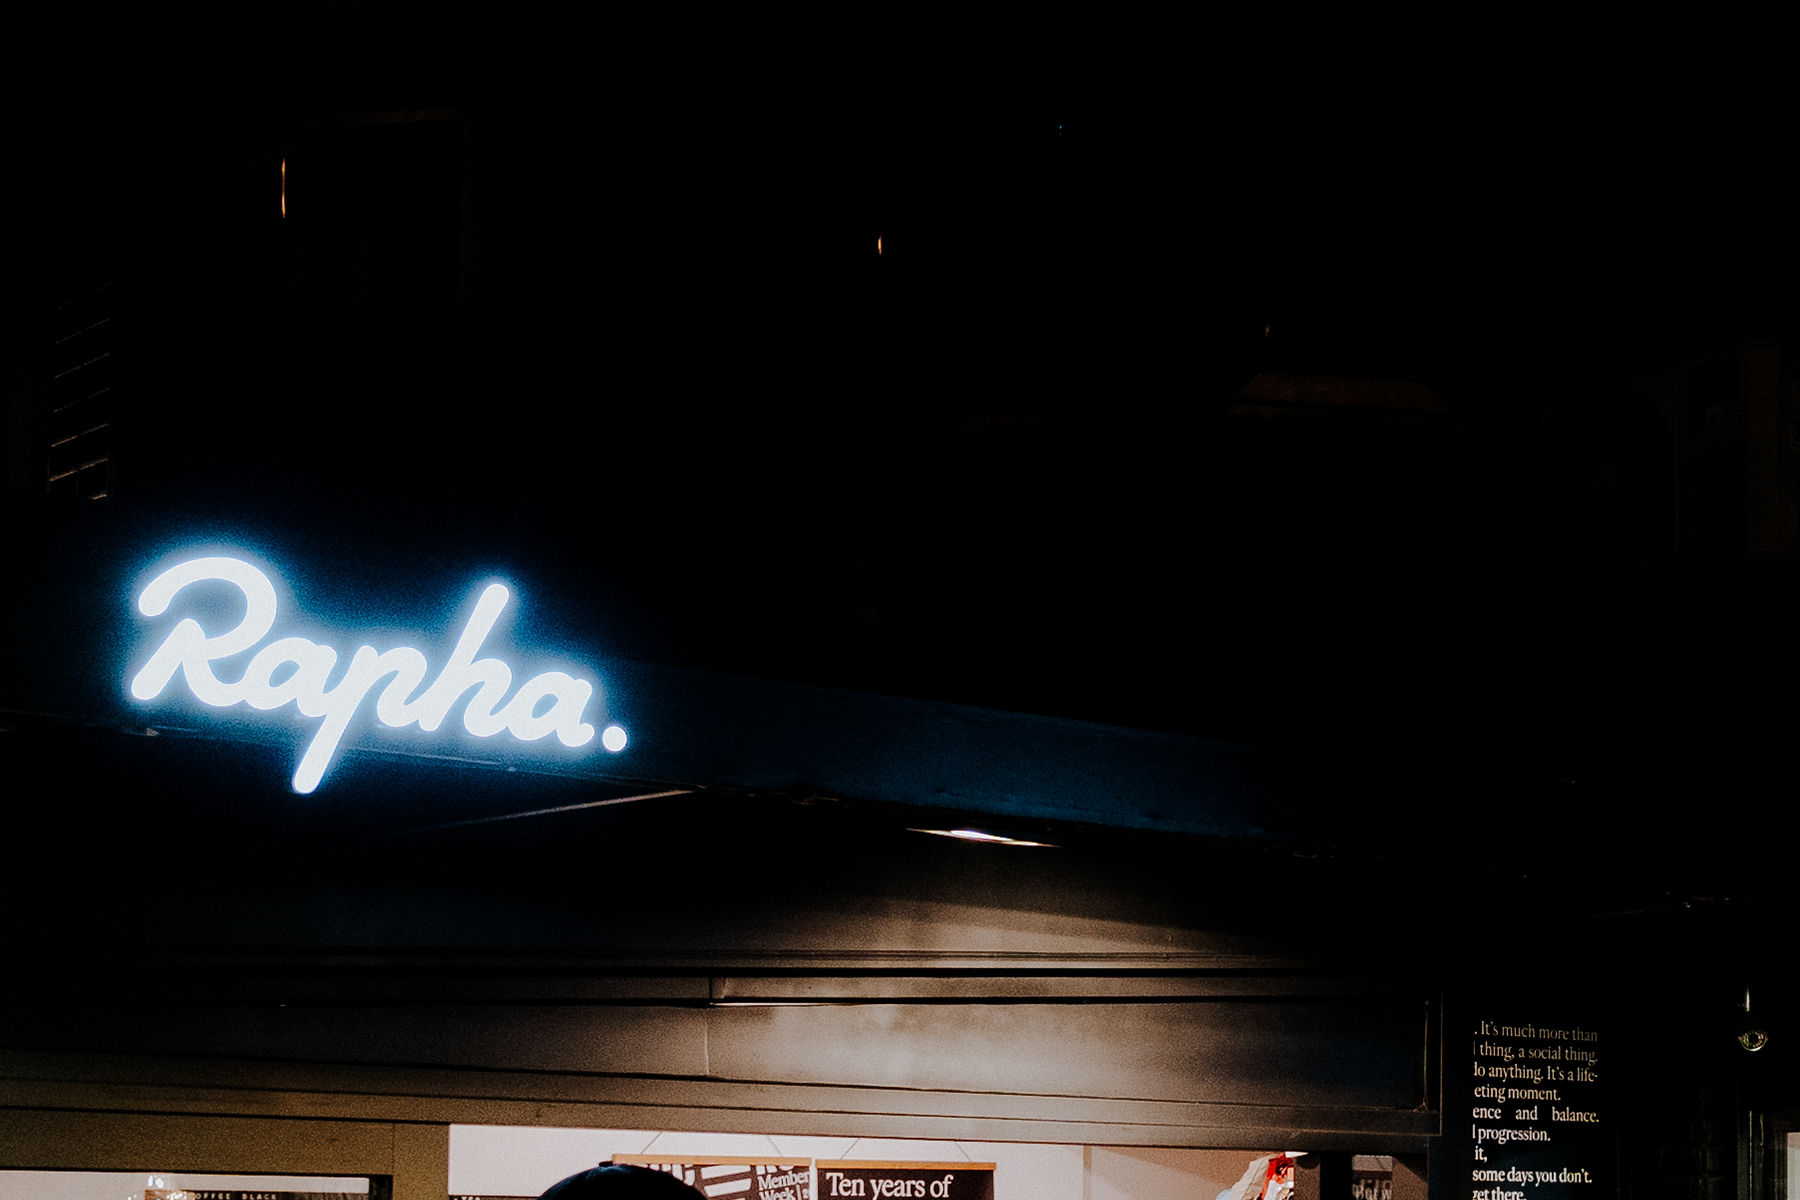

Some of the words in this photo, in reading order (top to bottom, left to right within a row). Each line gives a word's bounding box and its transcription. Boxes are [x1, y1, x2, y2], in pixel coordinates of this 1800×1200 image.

[131, 557, 628, 793] Rapha.
[1481, 1020, 1499, 1036] It's
[1502, 1023, 1536, 1039] much
[1539, 1028, 1569, 1040] more
[1572, 1026, 1598, 1042] than
[1479, 1041, 1515, 1062] thing,
[1518, 1048, 1525, 1058] a
[1528, 1046, 1562, 1060] social
[1488, 1063, 1544, 1084] anything.
[1547, 1065, 1565, 1081] It's
[1567, 1071, 1574, 1082] a
[1474, 1083, 1506, 1103] eting
[1508, 1088, 1561, 1101] moment.
[1472, 1106, 1502, 1119] ence
[1515, 1105, 1538, 1121] and
[1552, 1106, 1600, 1123] balance.
[1478, 1126, 1551, 1145] progression.
[1475, 1145, 1488, 1163] it,
[825, 1172, 866, 1198] Ten
[930, 1174, 955, 1198] of
[1472, 1169, 1505, 1182] some
[1507, 1166, 1534, 1187] days
[1535, 1170, 1557, 1187] you
[1559, 1167, 1592, 1183] don't.
